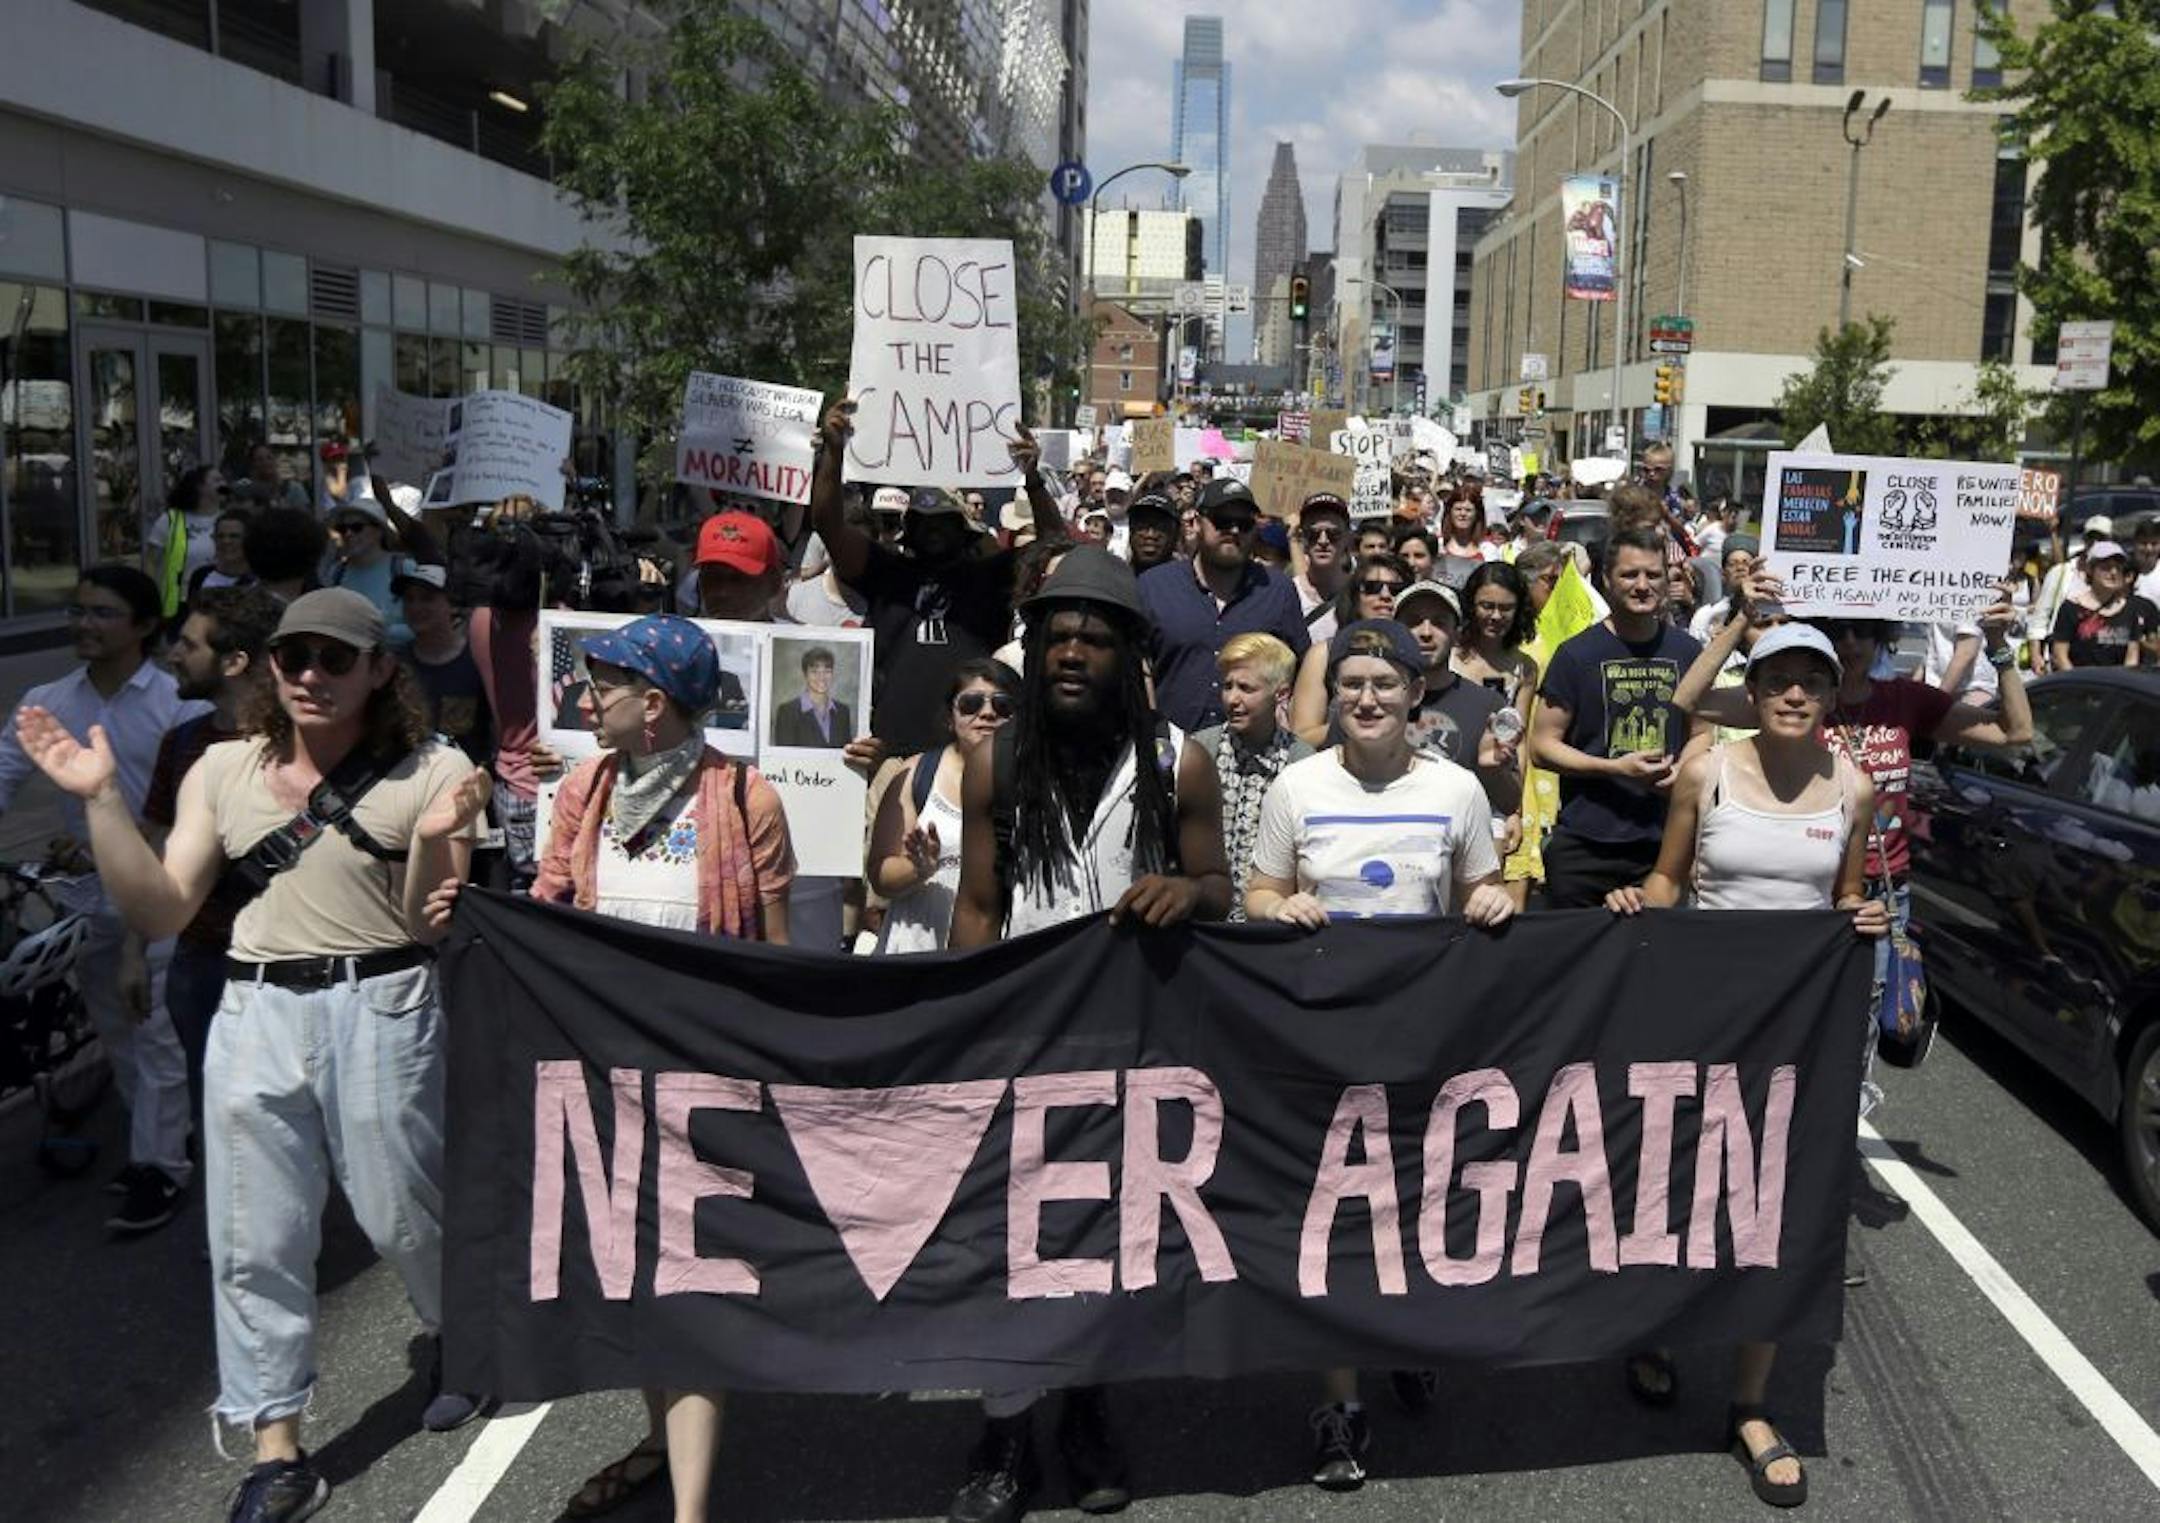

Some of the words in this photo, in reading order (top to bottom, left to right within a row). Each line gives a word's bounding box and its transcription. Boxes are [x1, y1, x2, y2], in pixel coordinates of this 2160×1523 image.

[862, 254, 1012, 329] CLOSE
[886, 342, 954, 374] THE
[692, 374, 716, 388] THE
[690, 389, 743, 409] SLAVERY
[745, 399, 771, 416] WAS
[850, 387, 1017, 475] CAMPS
[683, 449, 812, 499] MORALITY
[1887, 474, 1939, 490] CLOSE
[2020, 469, 2059, 493] ERO
[1782, 496, 1831, 511] MERECEN
[2017, 490, 2058, 517] NOW
[1781, 510, 1811, 522] ESTAR
[1792, 564, 1860, 583] FREE
[1871, 567, 1906, 584] THE
[1781, 584, 1826, 601] EVER
[1899, 590, 1922, 604] NO
[1929, 591, 1999, 607] DETENTIO
[795, 769, 837, 786] Order
[1298, 1060, 1797, 1300] AGAIN
